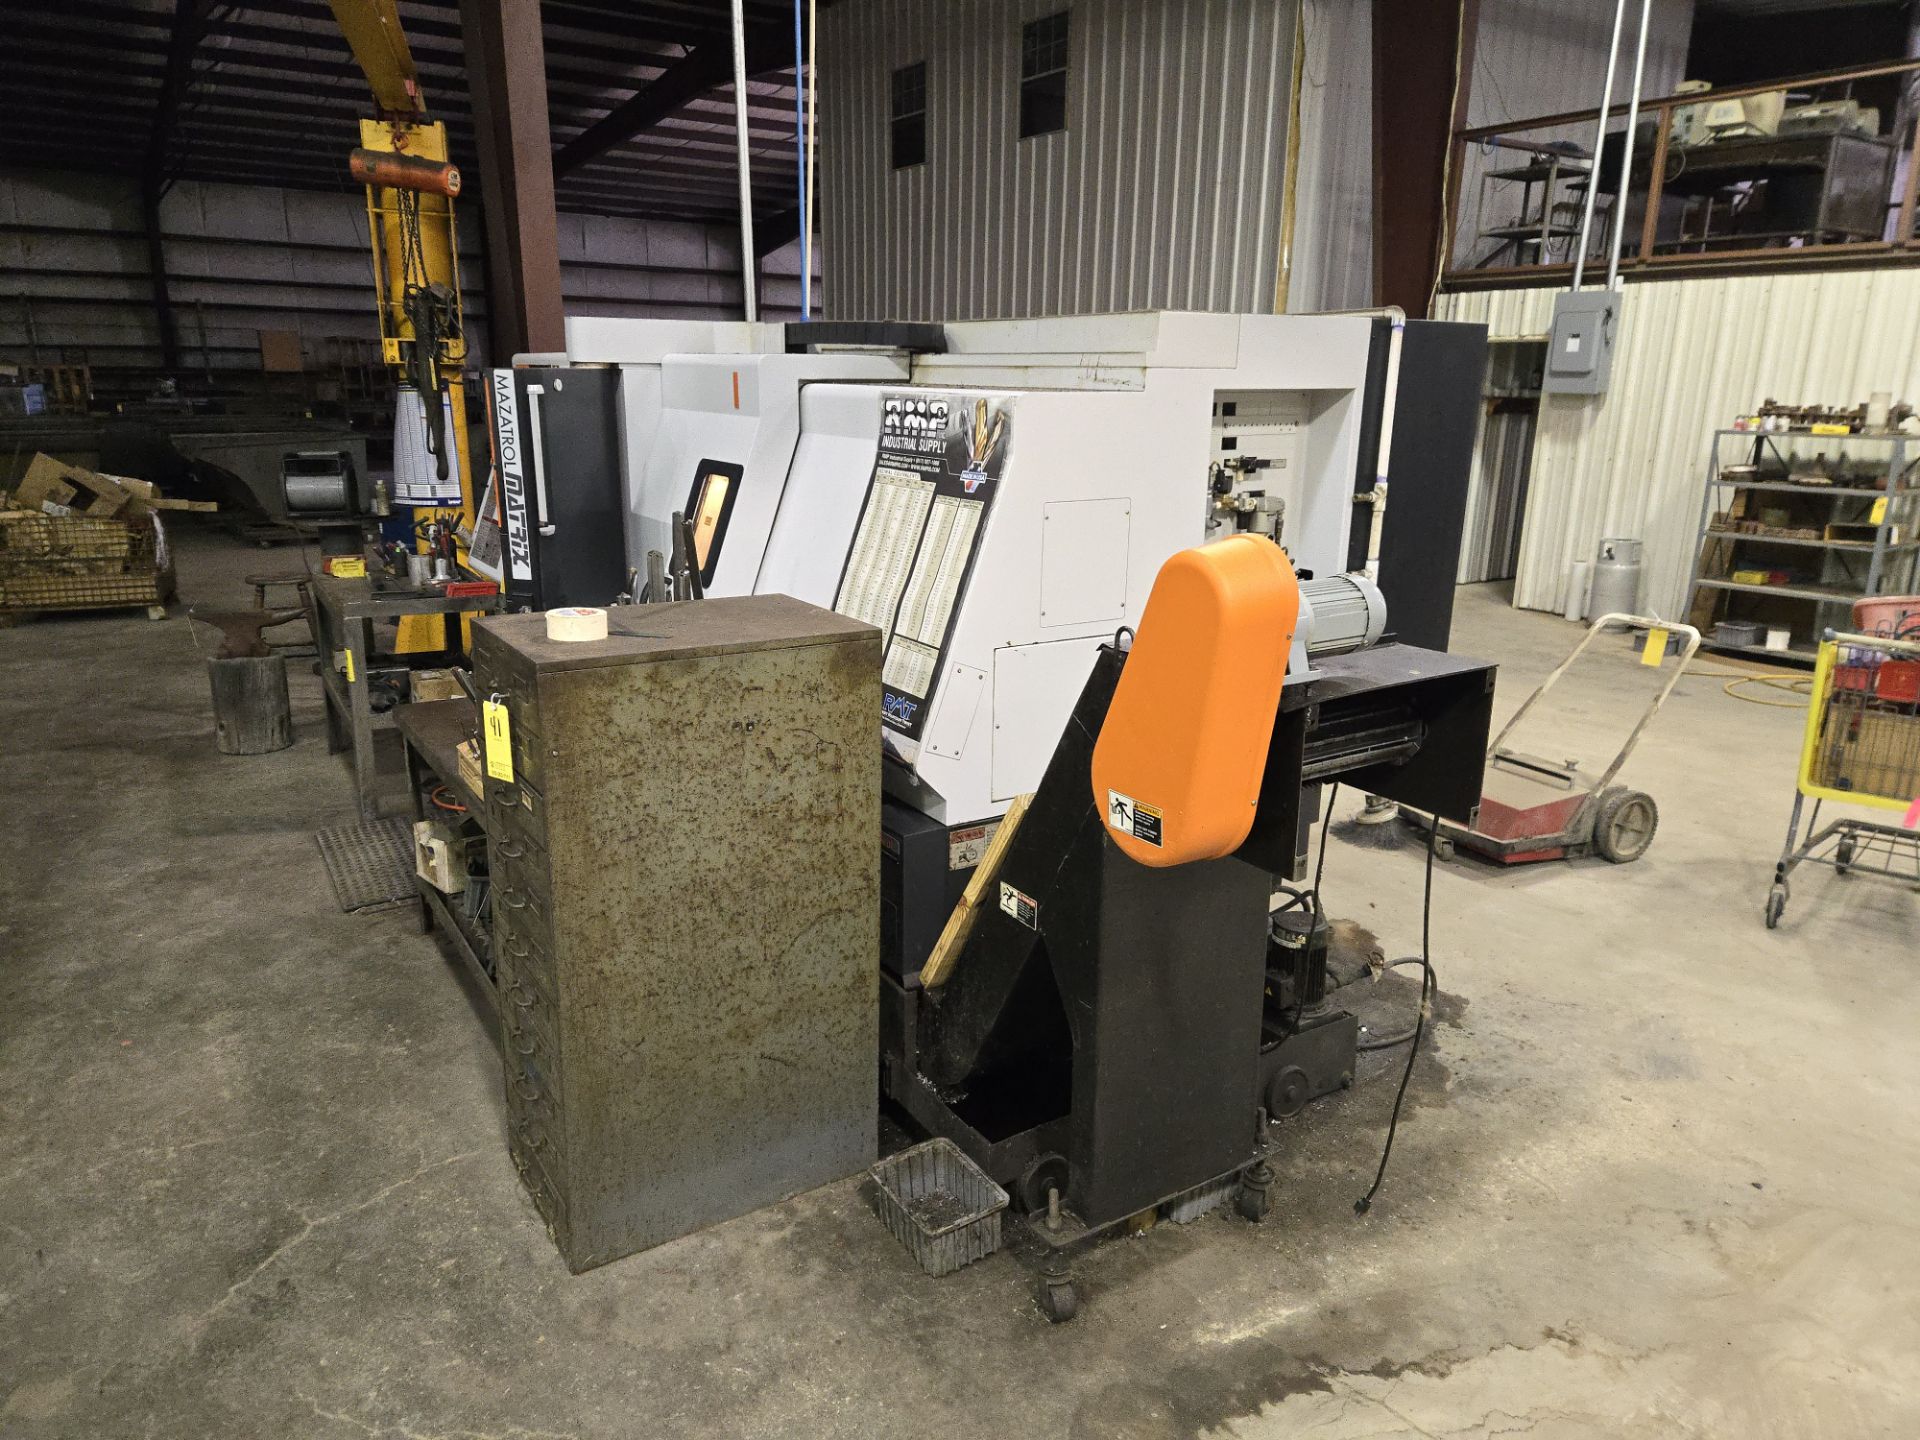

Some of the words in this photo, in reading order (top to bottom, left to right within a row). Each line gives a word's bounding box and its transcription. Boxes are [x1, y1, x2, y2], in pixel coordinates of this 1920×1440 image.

[495, 374, 517, 474] MAZATROL
[881, 435, 917, 451] INDUSTRIAL
[918, 439, 948, 454] SUPPLY
[882, 692, 918, 721] RMT
